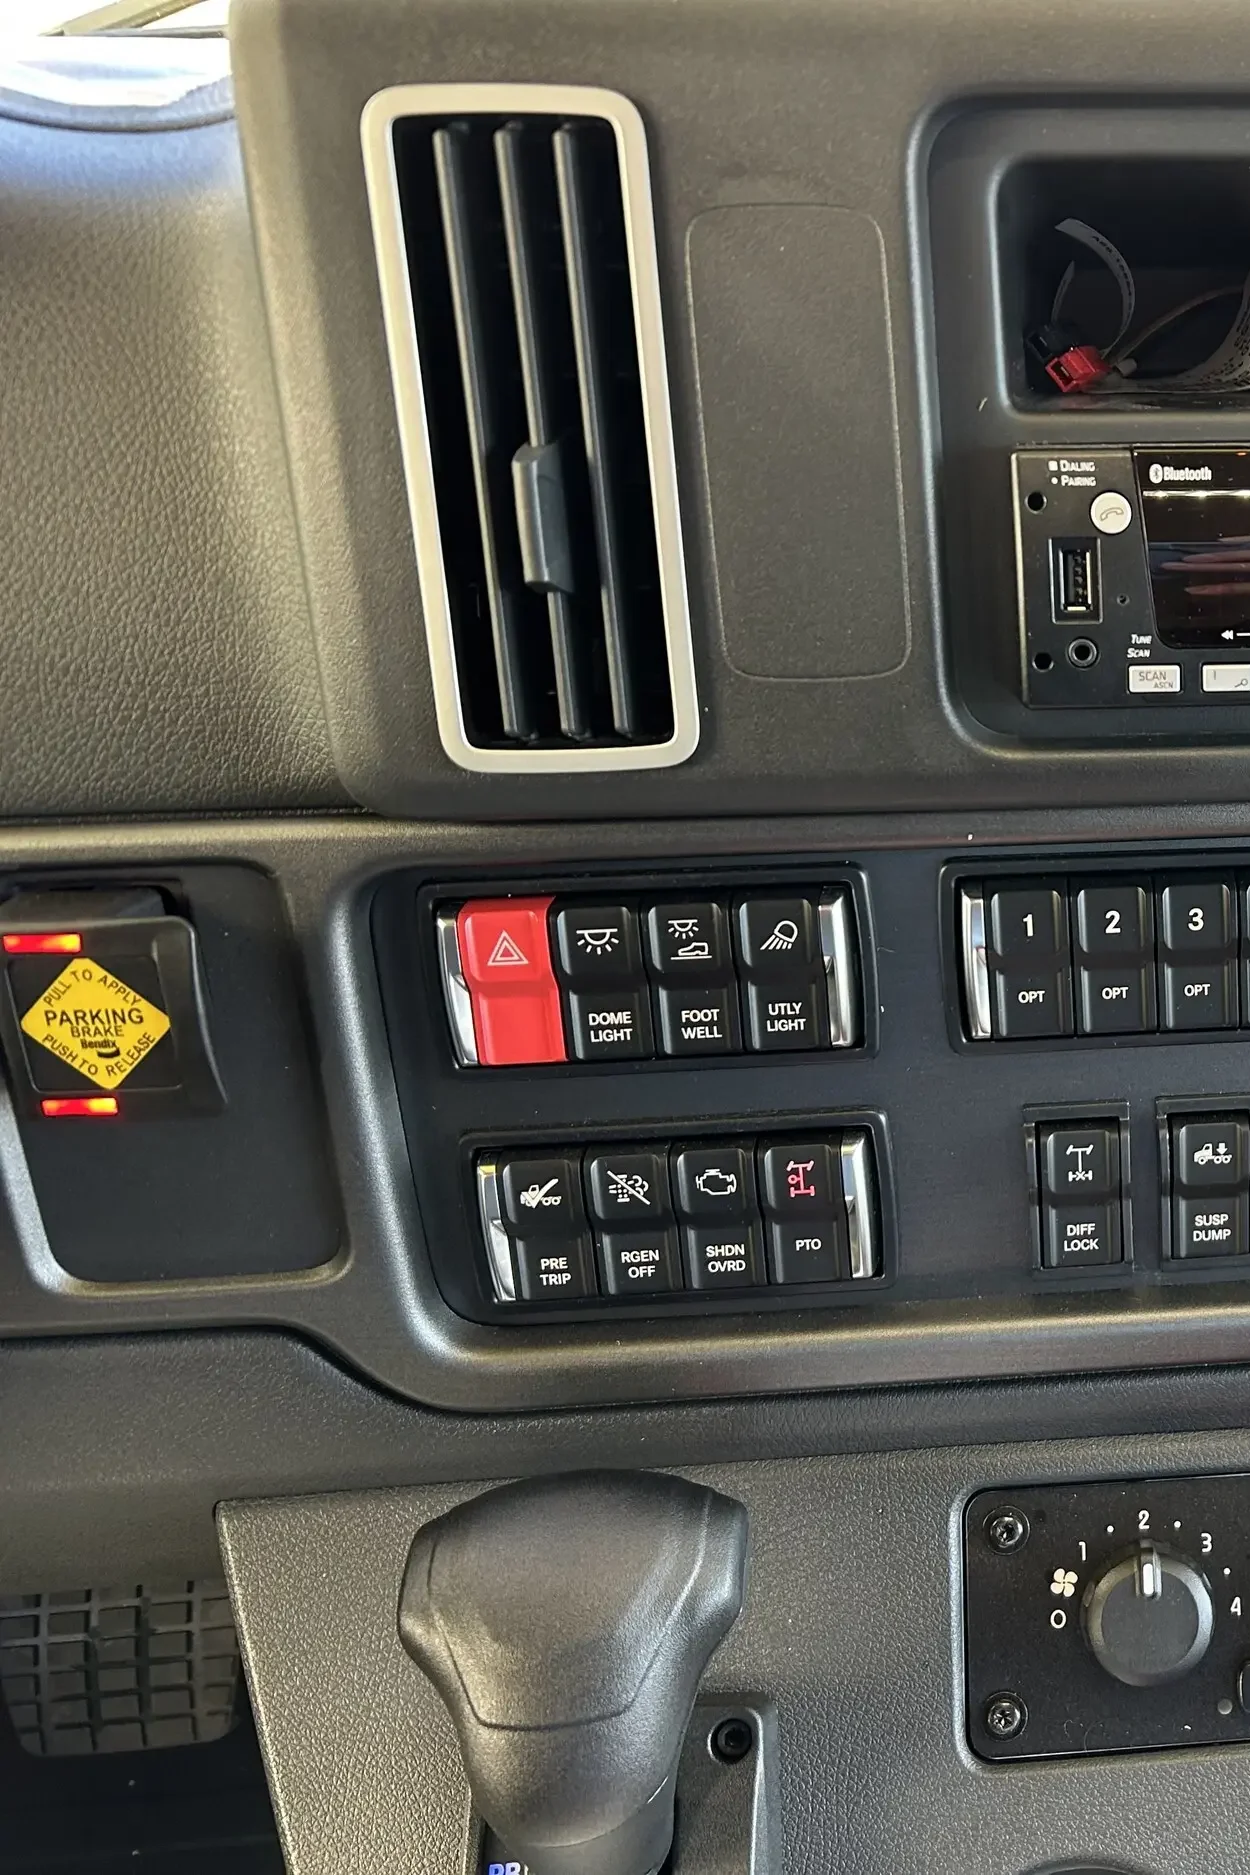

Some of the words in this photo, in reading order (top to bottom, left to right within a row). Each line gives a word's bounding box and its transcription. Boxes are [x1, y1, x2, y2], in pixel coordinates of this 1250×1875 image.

[1163, 466, 1212, 481] Bluetooth
[1138, 670, 1167, 682] SCAN
[1212, 670, 1217, 680] 1
[1154, 681, 1174, 690] ASCN
[1022, 914, 1034, 937] 1
[1104, 910, 1122, 934] 2
[1187, 907, 1204, 932] 3
[43, 980, 72, 1008] PULL
[70, 968, 92, 984] TO
[97, 974, 142, 1006] APPLY
[1101, 985, 1129, 1000] OPT
[1184, 982, 1211, 997] OPT
[1018, 989, 1046, 1004] OPT
[680, 1008, 720, 1024] FOOT
[768, 1002, 802, 1016] UTLY
[44, 1008, 144, 1026] PARKING
[588, 1012, 632, 1026] DOME
[70, 1024, 125, 1038] BRAKE
[681, 1025, 722, 1040] WELL
[766, 1018, 806, 1033] LIGHT
[590, 1028, 633, 1043] LIGHT
[80, 1038, 118, 1050] Bendix
[42, 1034, 78, 1063] PUSH
[80, 1058, 98, 1076] TO
[105, 1032, 157, 1078] RELEASE
[1194, 1213, 1229, 1227] SUSP
[1066, 1222, 1096, 1236] DIFF
[1192, 1228, 1232, 1242] DUMP
[706, 1243, 746, 1258] SHDN
[795, 1238, 822, 1252] PTO
[1064, 1238, 1100, 1252] LOCK
[540, 1256, 568, 1270] PRE
[620, 1249, 660, 1264] RGEN
[628, 1264, 656, 1279] OFF
[707, 1259, 746, 1274] OVRD
[540, 1272, 572, 1287] TRIP
[1138, 1510, 1150, 1530] 2
[1200, 1532, 1212, 1553] 3
[1078, 1541, 1087, 1561] 1
[1230, 1596, 1242, 1616] 4
